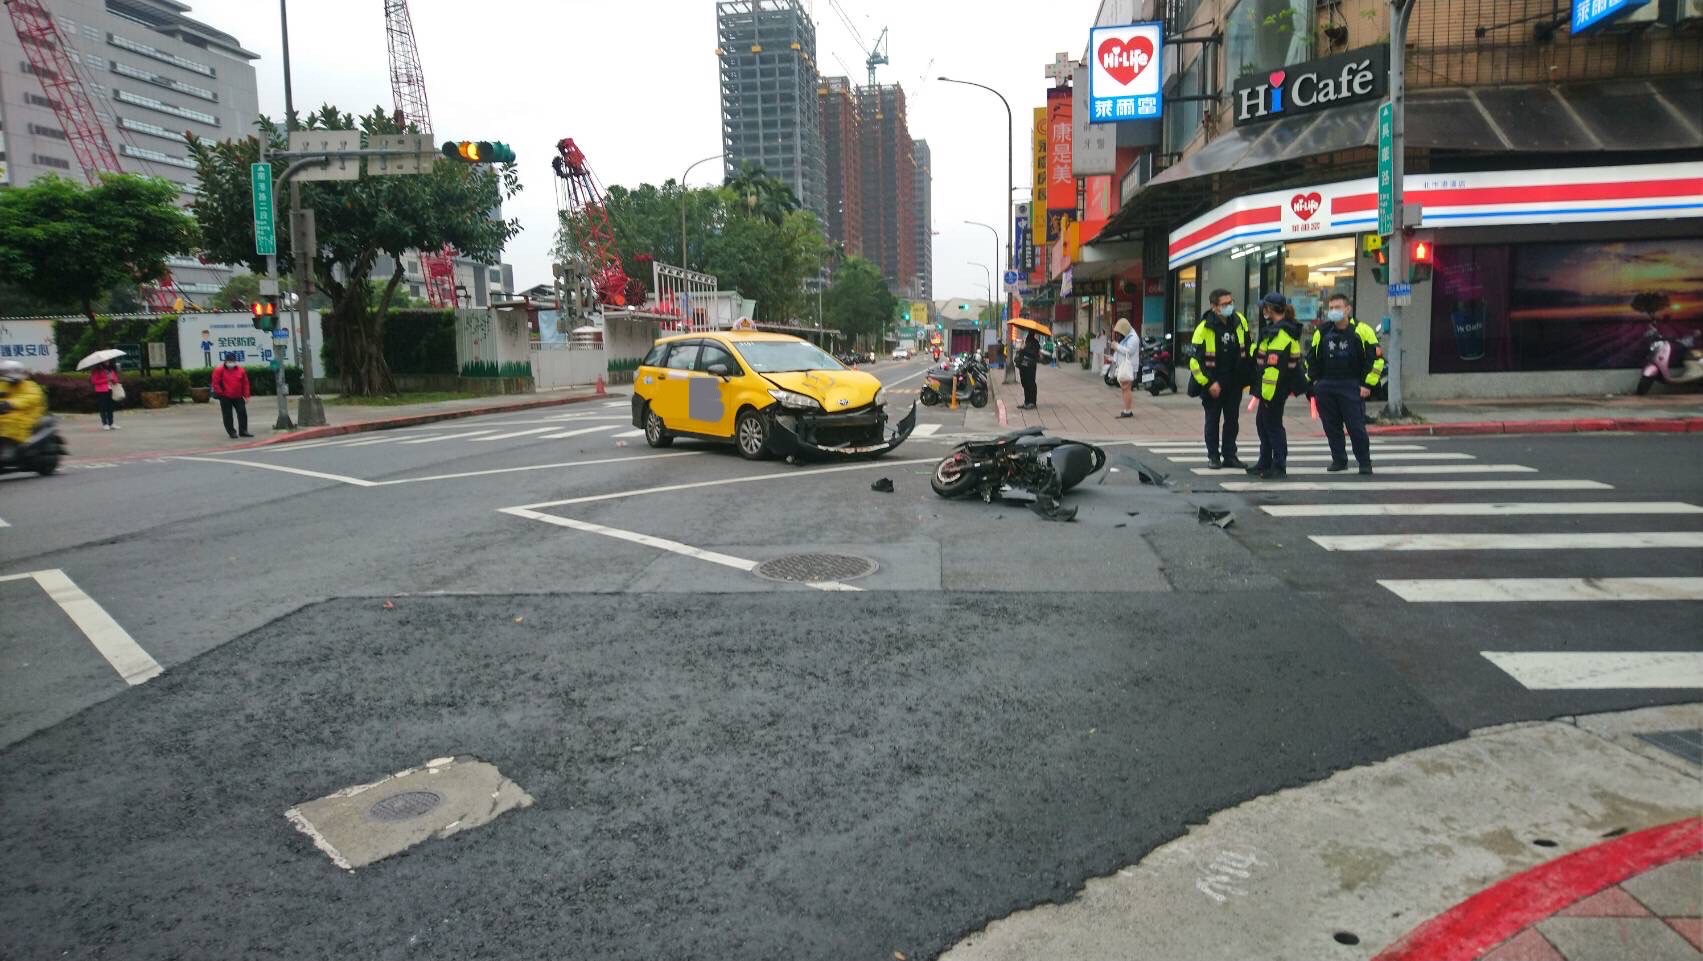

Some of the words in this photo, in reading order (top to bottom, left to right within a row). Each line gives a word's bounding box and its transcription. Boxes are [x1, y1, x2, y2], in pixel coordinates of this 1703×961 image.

[1576, 0, 1621, 26] 萊爾
[1238, 70, 1285, 120] Hi
[1291, 59, 1374, 107] Café
[1094, 97, 1157, 118] 萊爾富
[1052, 122, 1072, 184] 康是美
[218, 336, 256, 347] 全民防疫
